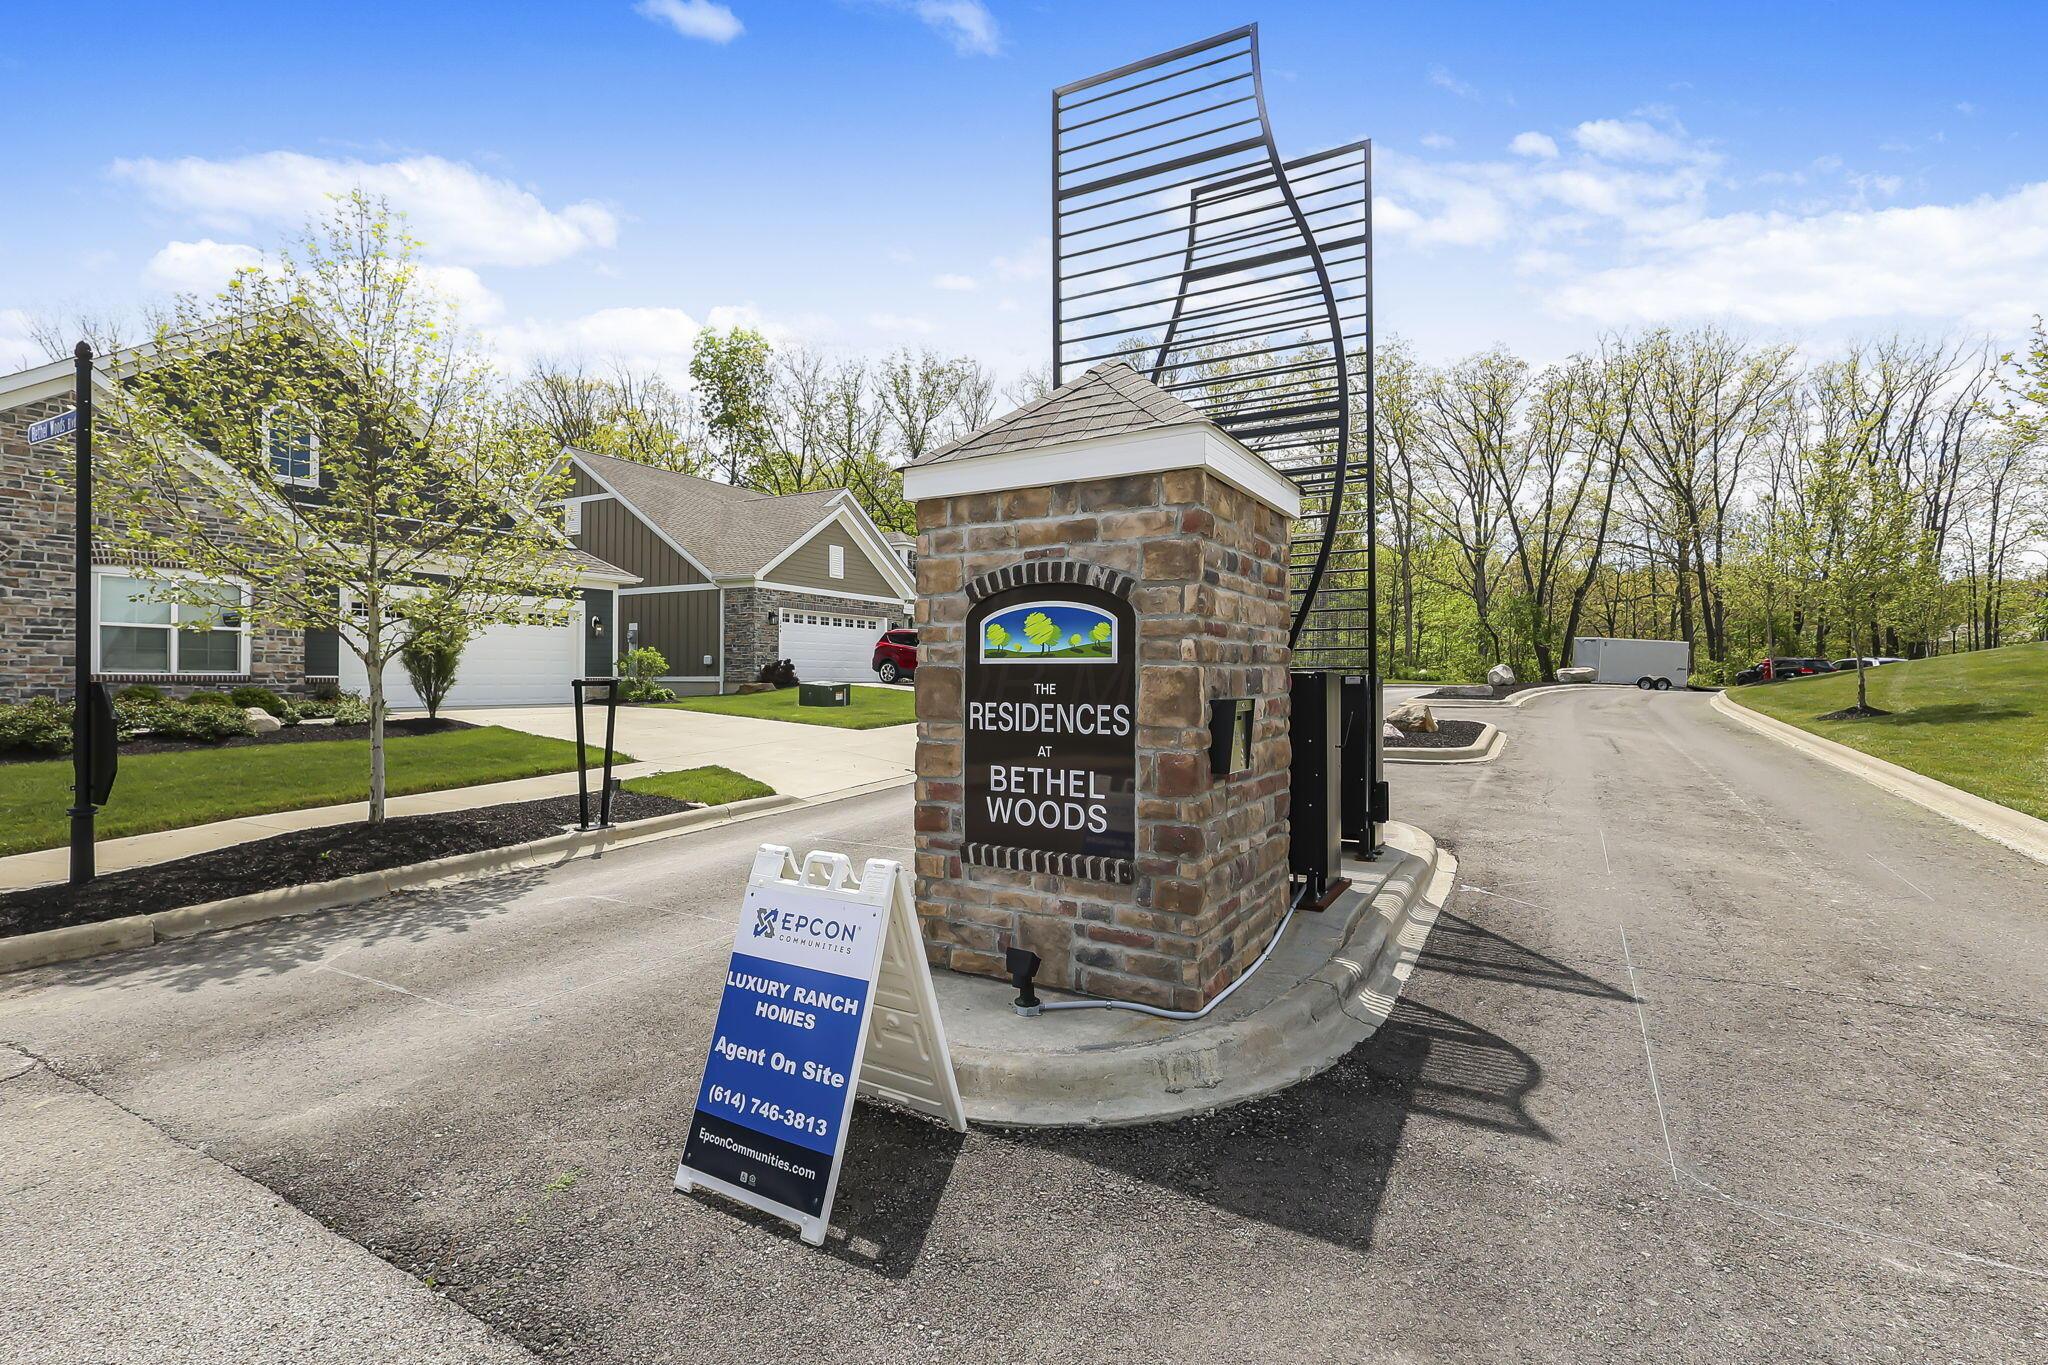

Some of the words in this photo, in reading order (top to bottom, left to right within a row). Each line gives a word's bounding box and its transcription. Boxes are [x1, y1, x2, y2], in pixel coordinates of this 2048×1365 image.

[50, 417, 66, 435] Woods
[1034, 683, 1057, 695] THE
[969, 701, 1130, 736] RESIDENCES
[1037, 745, 1053, 758] AT
[990, 765, 1105, 799] BETHEL
[986, 796, 1107, 833] WOODS
[781, 912, 857, 942] EPCON
[779, 934, 852, 955] COMMUNITIES
[726, 970, 790, 999] LUXURY
[793, 986, 859, 1016] RANCH
[755, 1001, 816, 1030] HOMES
[714, 1035, 766, 1066] Agent
[770, 1052, 797, 1075] On
[802, 1060, 845, 1088] Site
[709, 1084, 746, 1114] (614)
[750, 1097, 828, 1137] 746-3813
[699, 1127, 816, 1180] EpconCommunities.com
